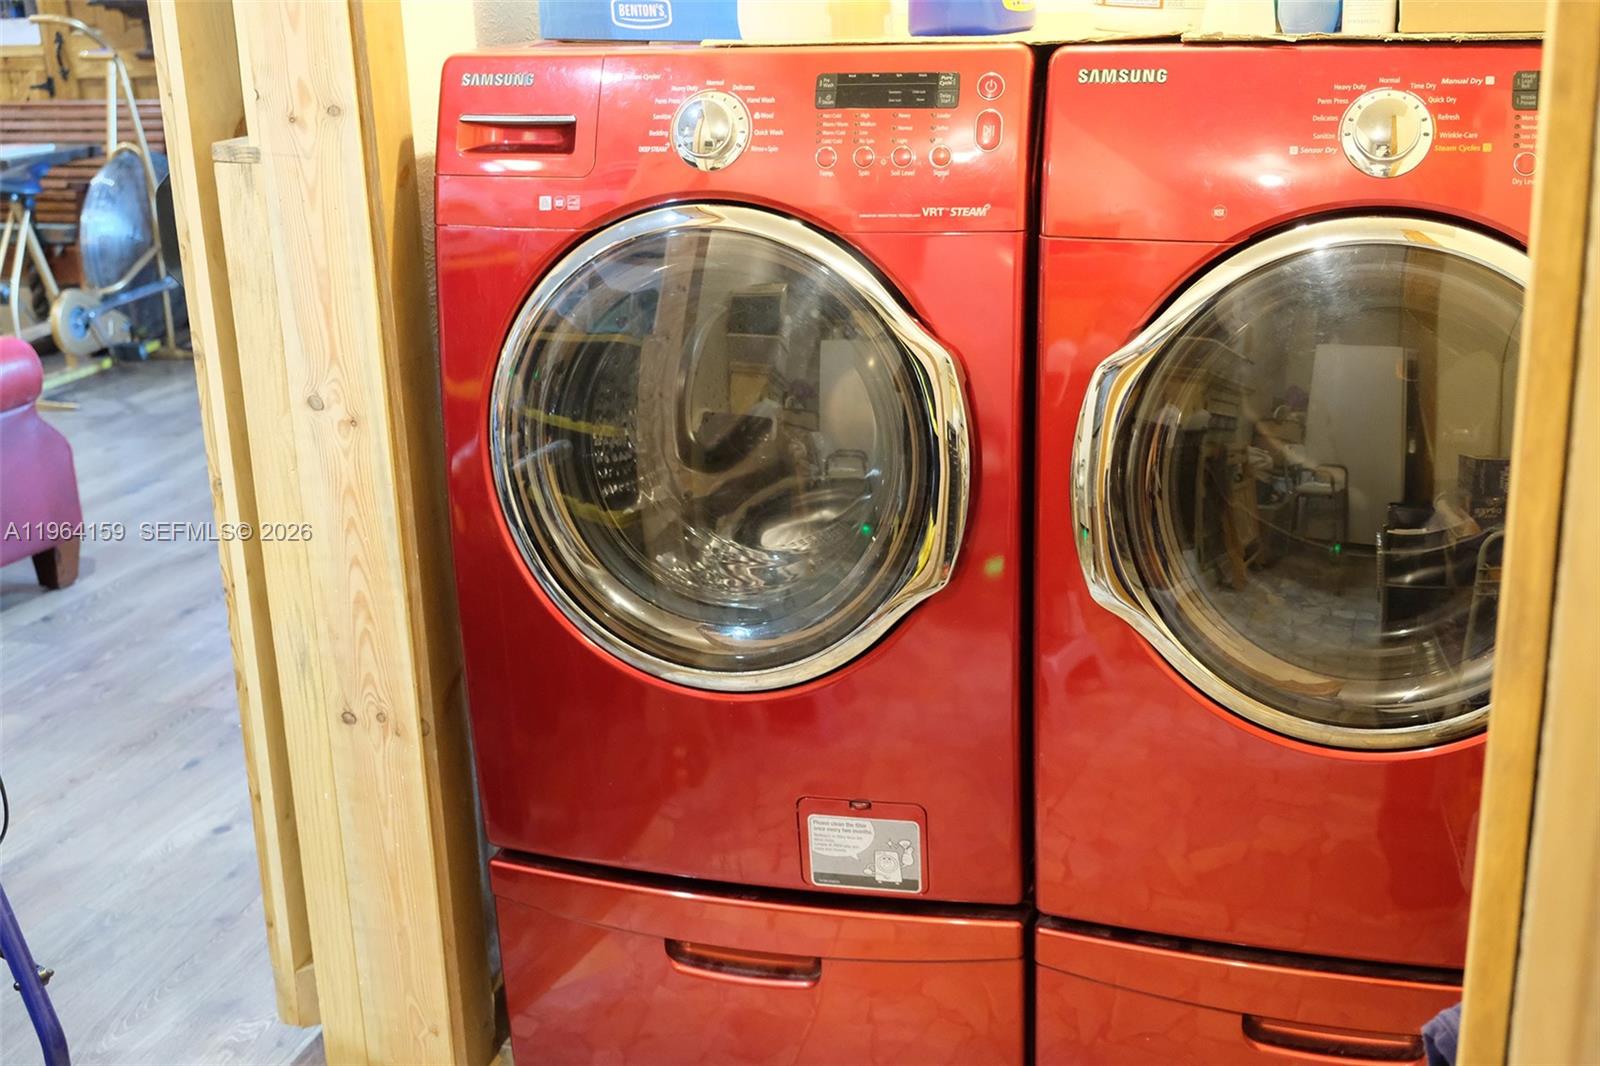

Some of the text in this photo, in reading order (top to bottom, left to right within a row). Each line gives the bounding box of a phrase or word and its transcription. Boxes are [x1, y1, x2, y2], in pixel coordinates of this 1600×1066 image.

[618, 3, 665, 17] BENTON'S
[461, 72, 535, 87] SAMSUNG
[1077, 68, 1169, 83] SAMSUNG
[1426, 83, 1437, 91] Dry
[1470, 78, 1483, 86] Dry
[922, 207, 944, 217] VRT
[950, 207, 985, 217] STEAM
